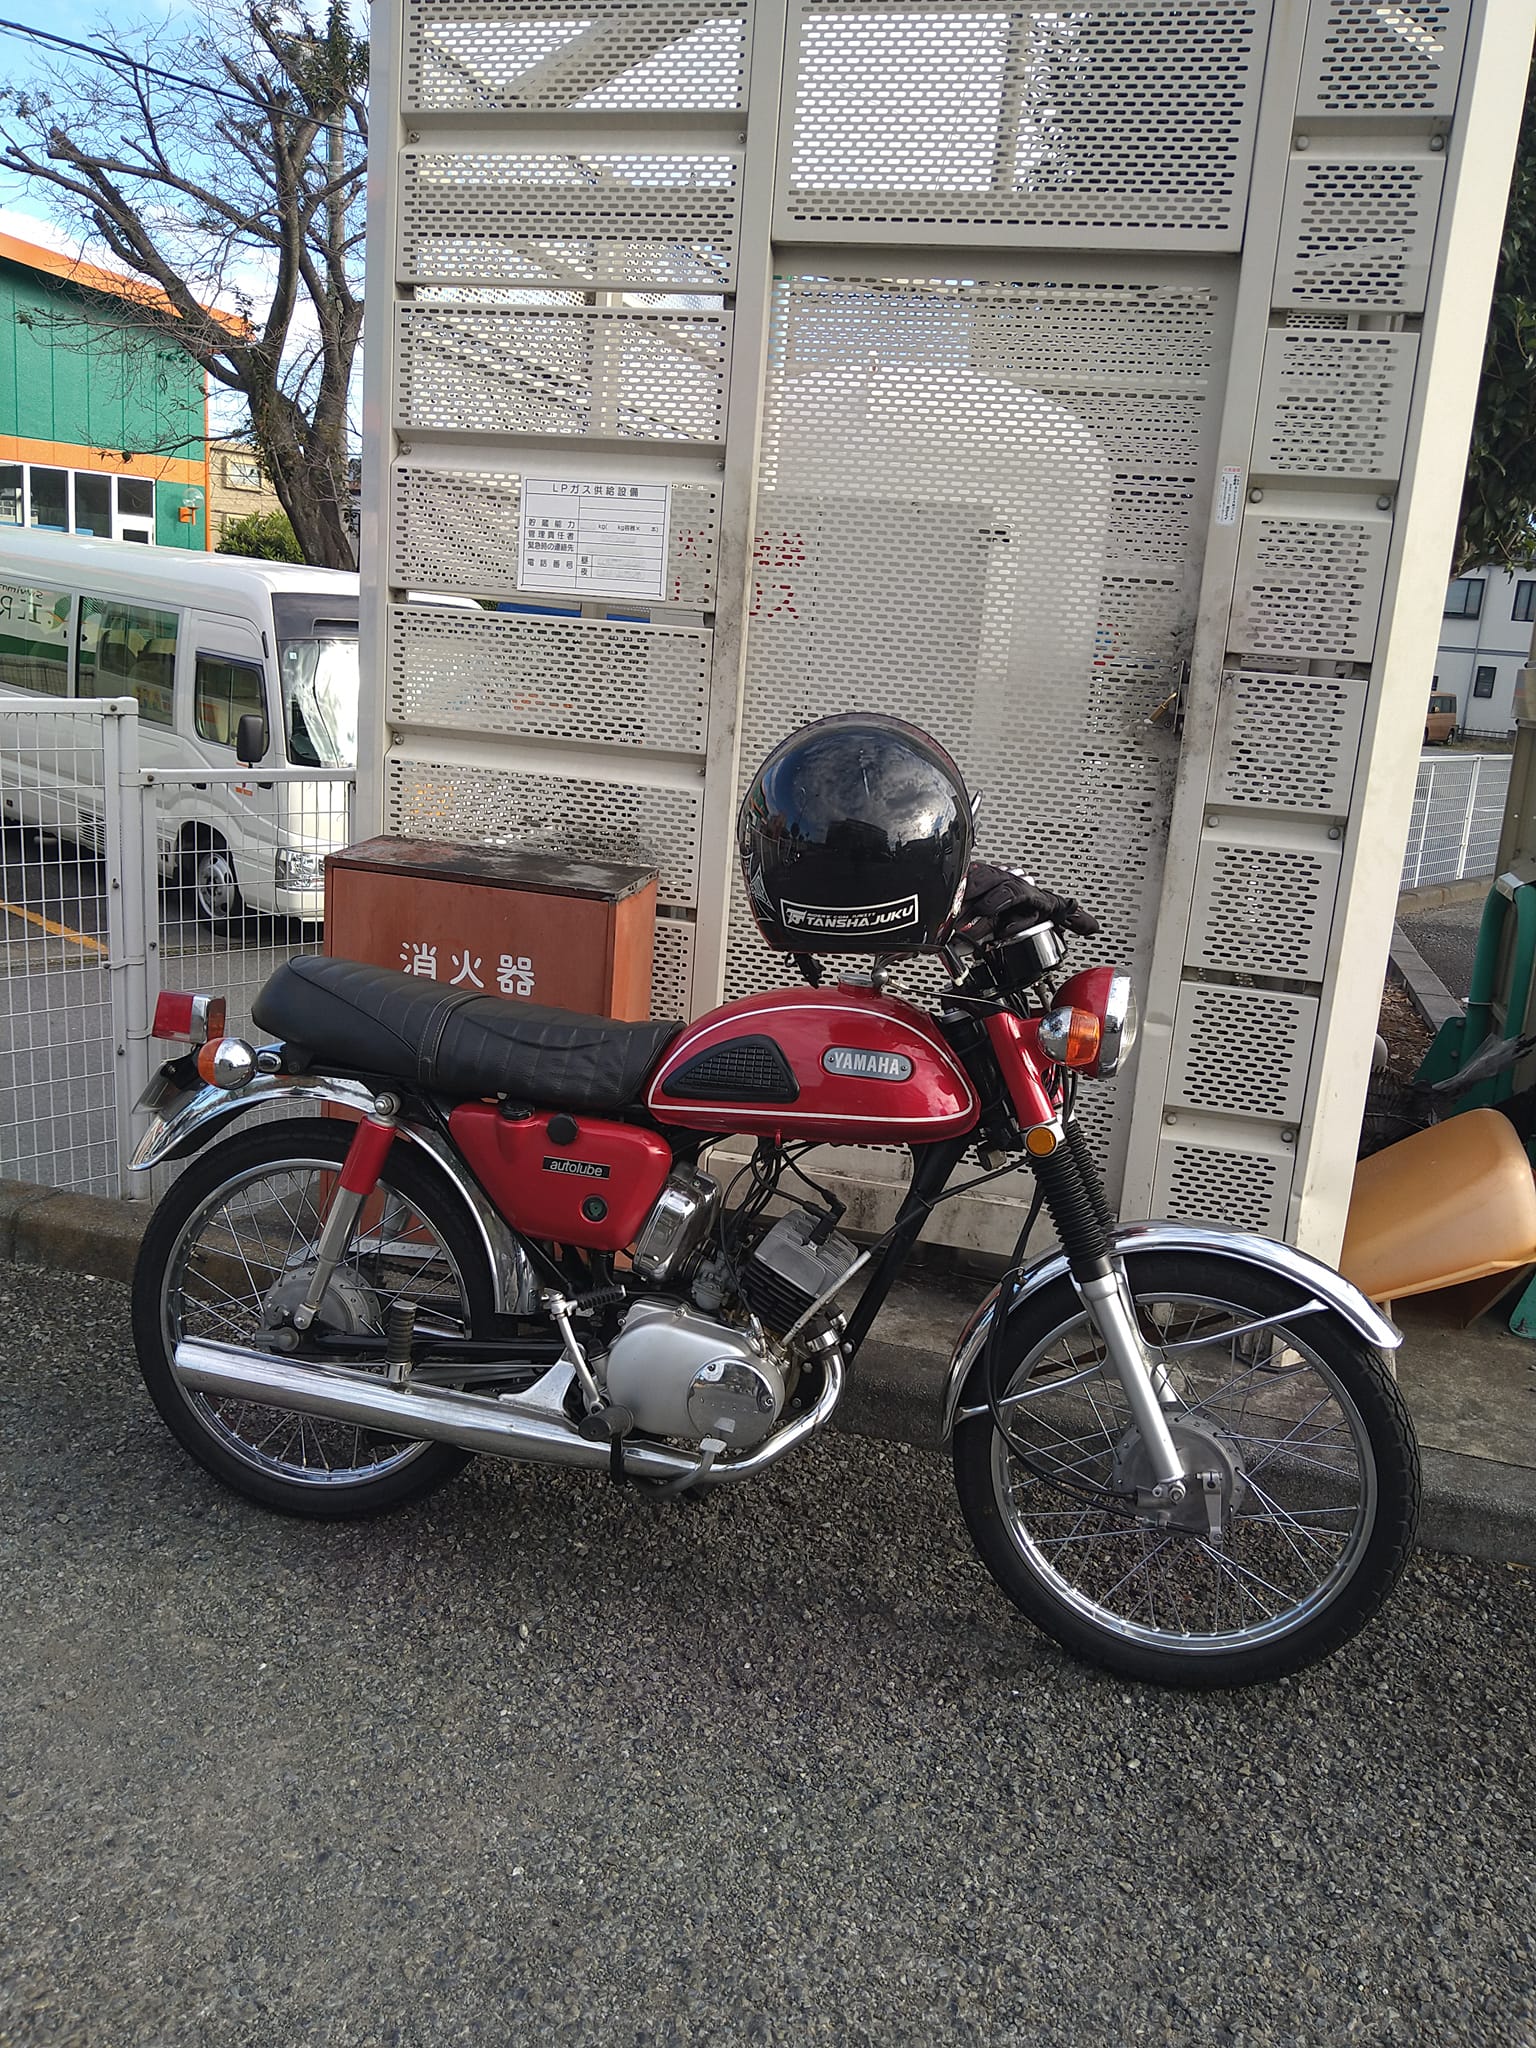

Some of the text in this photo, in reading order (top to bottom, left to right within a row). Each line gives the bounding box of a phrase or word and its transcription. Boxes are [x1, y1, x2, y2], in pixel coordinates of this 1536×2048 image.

[552, 484, 639, 497] LPガス供給設備
[806, 905, 914, 928] TANSHAJUKU
[399, 942, 536, 997] 消火器
[834, 1052, 899, 1075] YAMAHA
[550, 1160, 603, 1176] autolube
